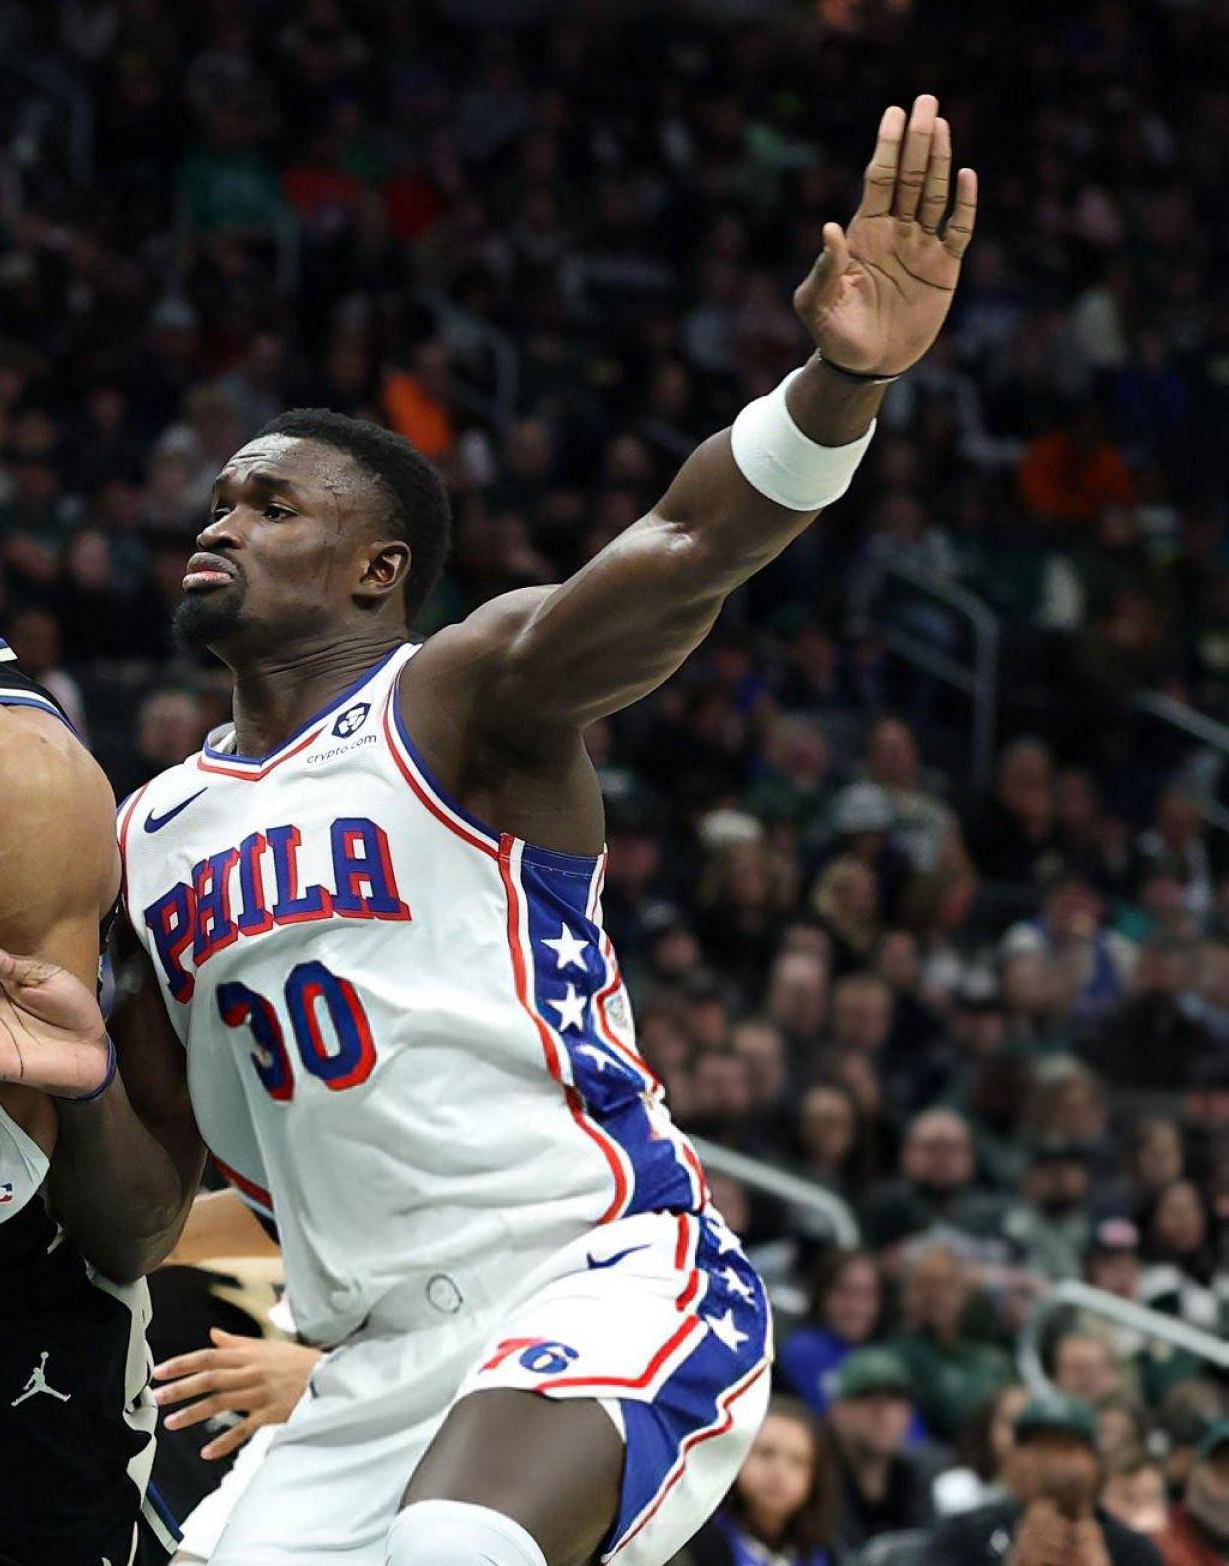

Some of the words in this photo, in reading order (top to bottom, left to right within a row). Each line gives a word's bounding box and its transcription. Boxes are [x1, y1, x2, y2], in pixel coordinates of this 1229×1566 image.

[307, 734, 377, 764] crypto.com
[144, 817, 412, 1004] PHILA
[215, 960, 377, 1102] 30
[478, 1337, 580, 1374] 76
